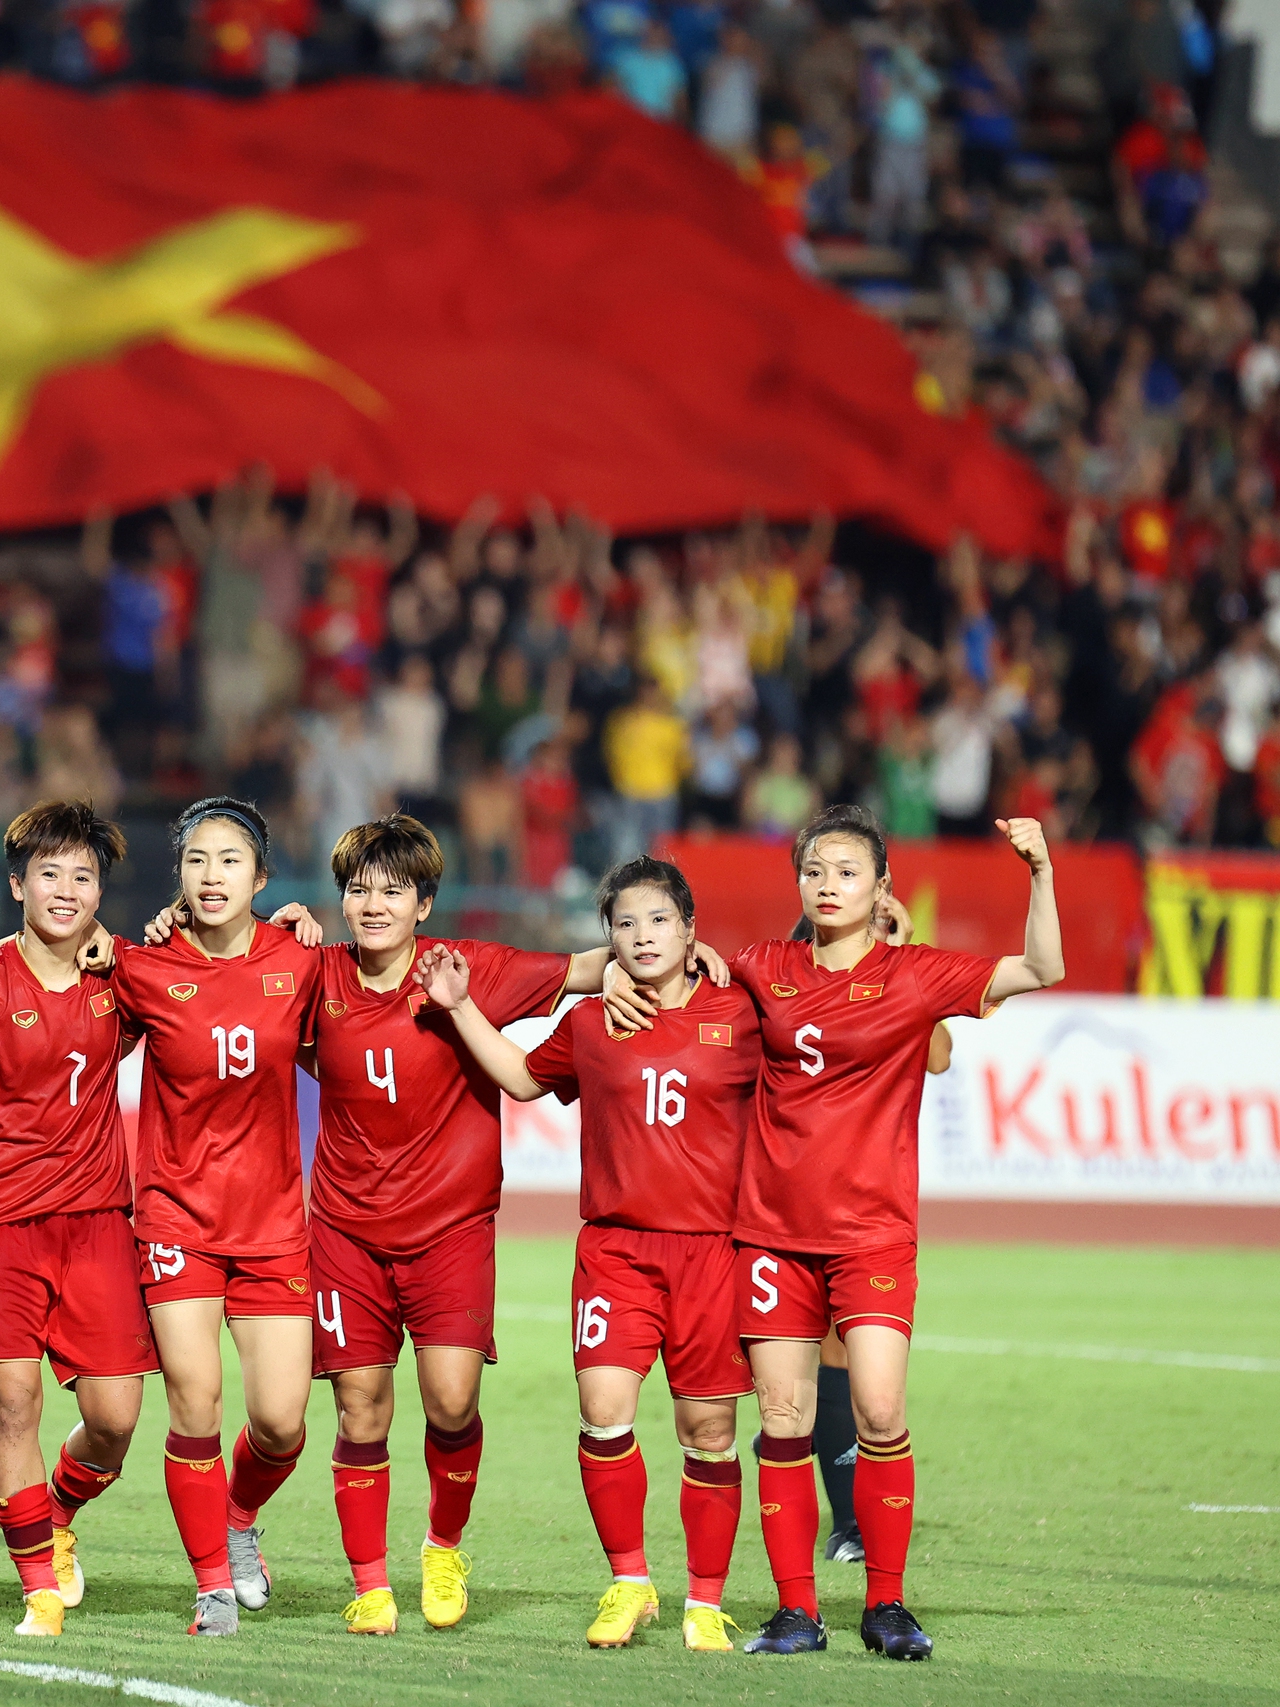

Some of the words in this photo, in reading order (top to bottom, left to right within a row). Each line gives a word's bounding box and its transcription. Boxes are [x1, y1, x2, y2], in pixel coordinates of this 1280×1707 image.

[64, 1050, 87, 1107] 7
[211, 1024, 256, 1080] 19
[365, 1047, 397, 1104] 4
[794, 1023, 826, 1077] 5
[641, 1066, 688, 1128] 16
[980, 1055, 1280, 1160] Kulen
[751, 1255, 779, 1314] 5
[316, 1289, 347, 1348] 4
[574, 1295, 611, 1353] 16
